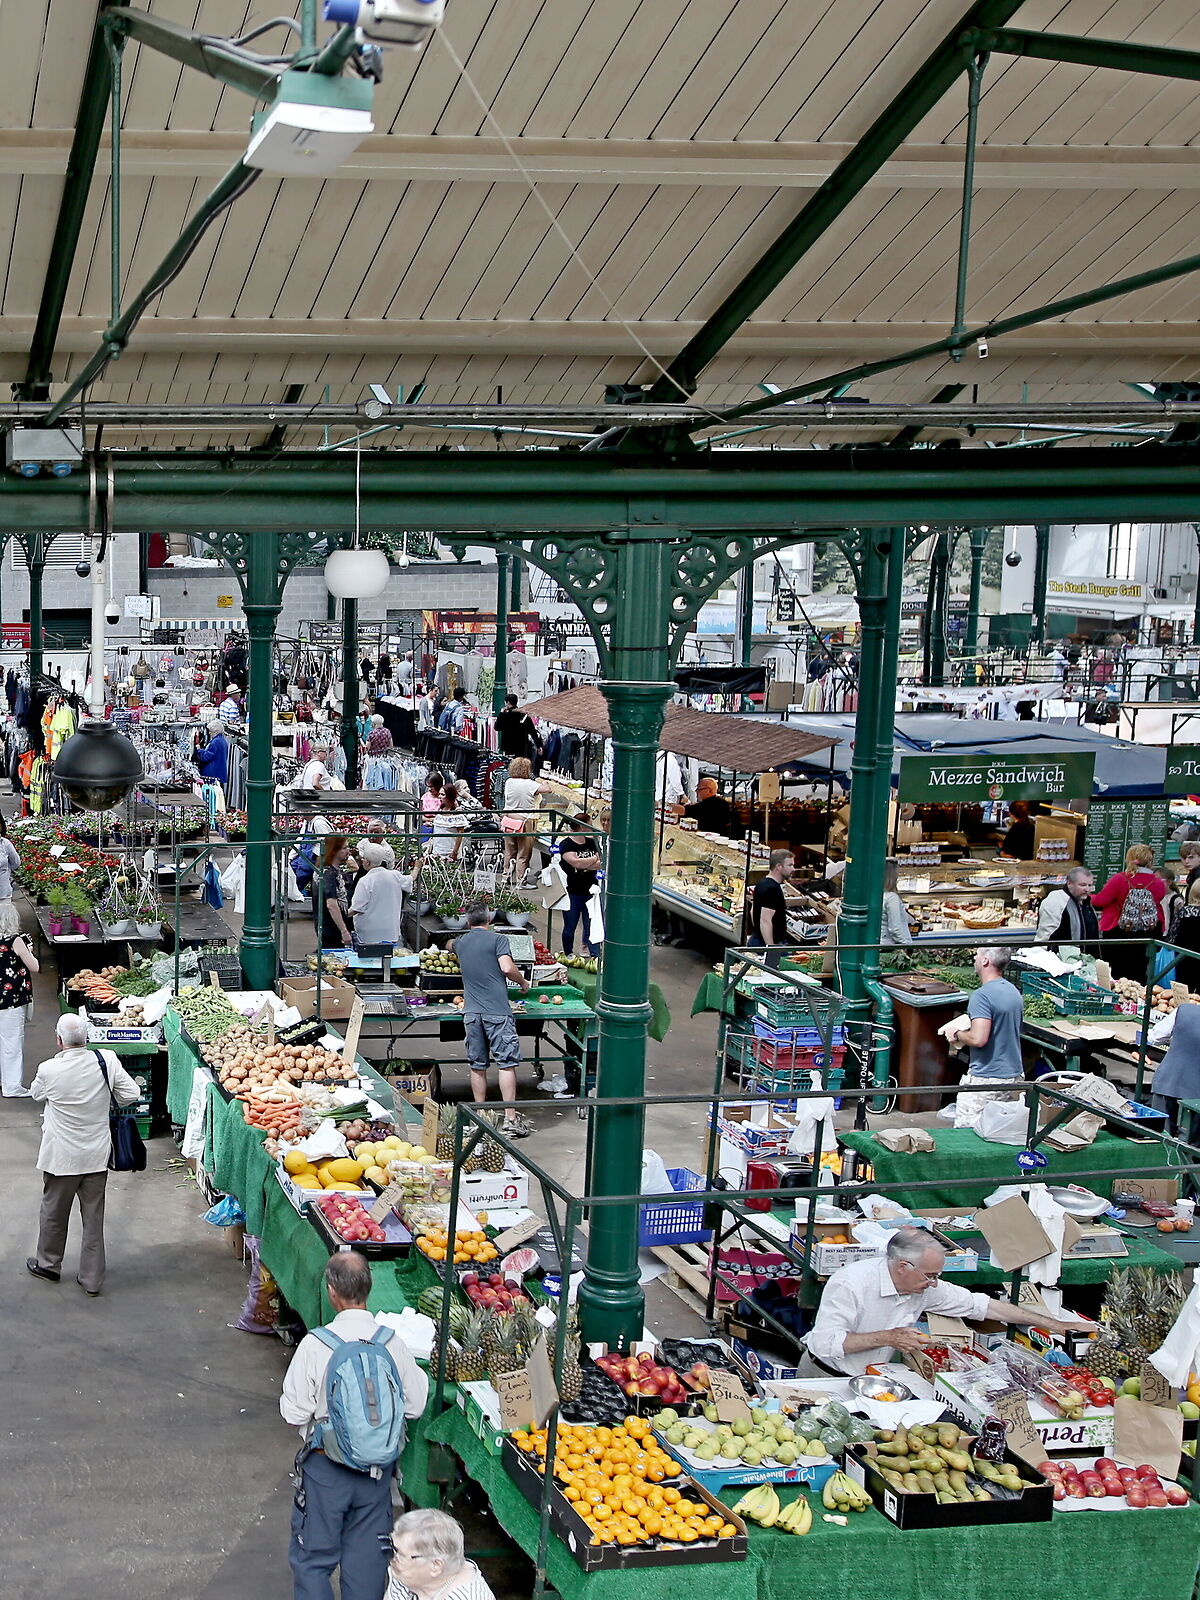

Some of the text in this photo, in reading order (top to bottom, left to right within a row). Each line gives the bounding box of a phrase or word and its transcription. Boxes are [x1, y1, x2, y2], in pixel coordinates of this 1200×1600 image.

[1049, 581, 1142, 598] The Steak Burger Grill
[928, 766, 1065, 786] Mezze Sandwich
[1045, 783, 1065, 793] Bar
[860, 1061, 868, 1077] PRO
